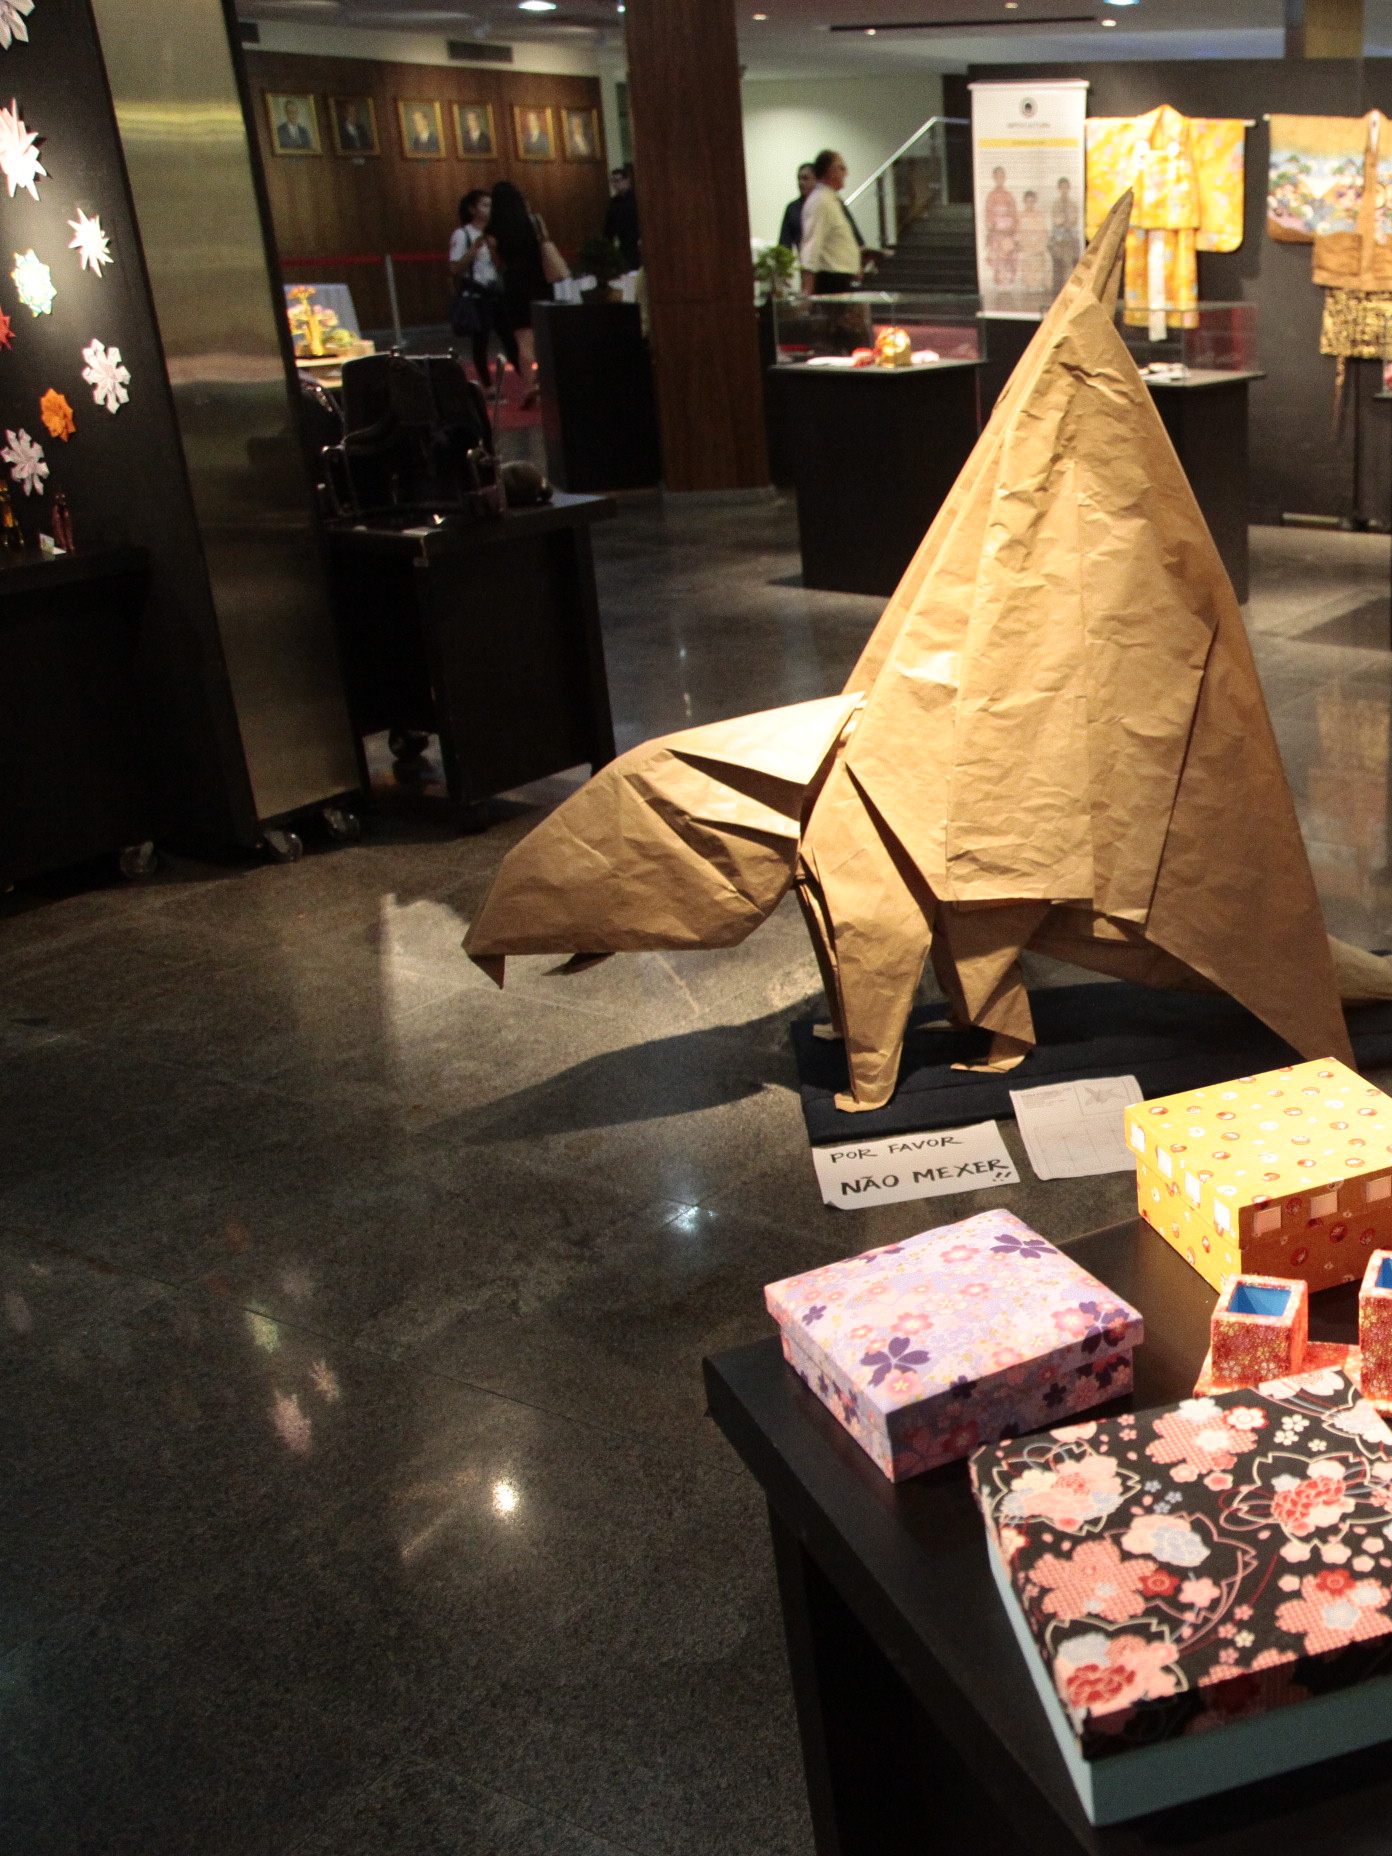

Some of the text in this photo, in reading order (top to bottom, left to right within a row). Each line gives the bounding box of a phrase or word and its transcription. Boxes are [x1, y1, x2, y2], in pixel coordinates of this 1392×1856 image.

[831, 1135, 963, 1164] POR FAVOR
[841, 1174, 900, 1196] NÃO
